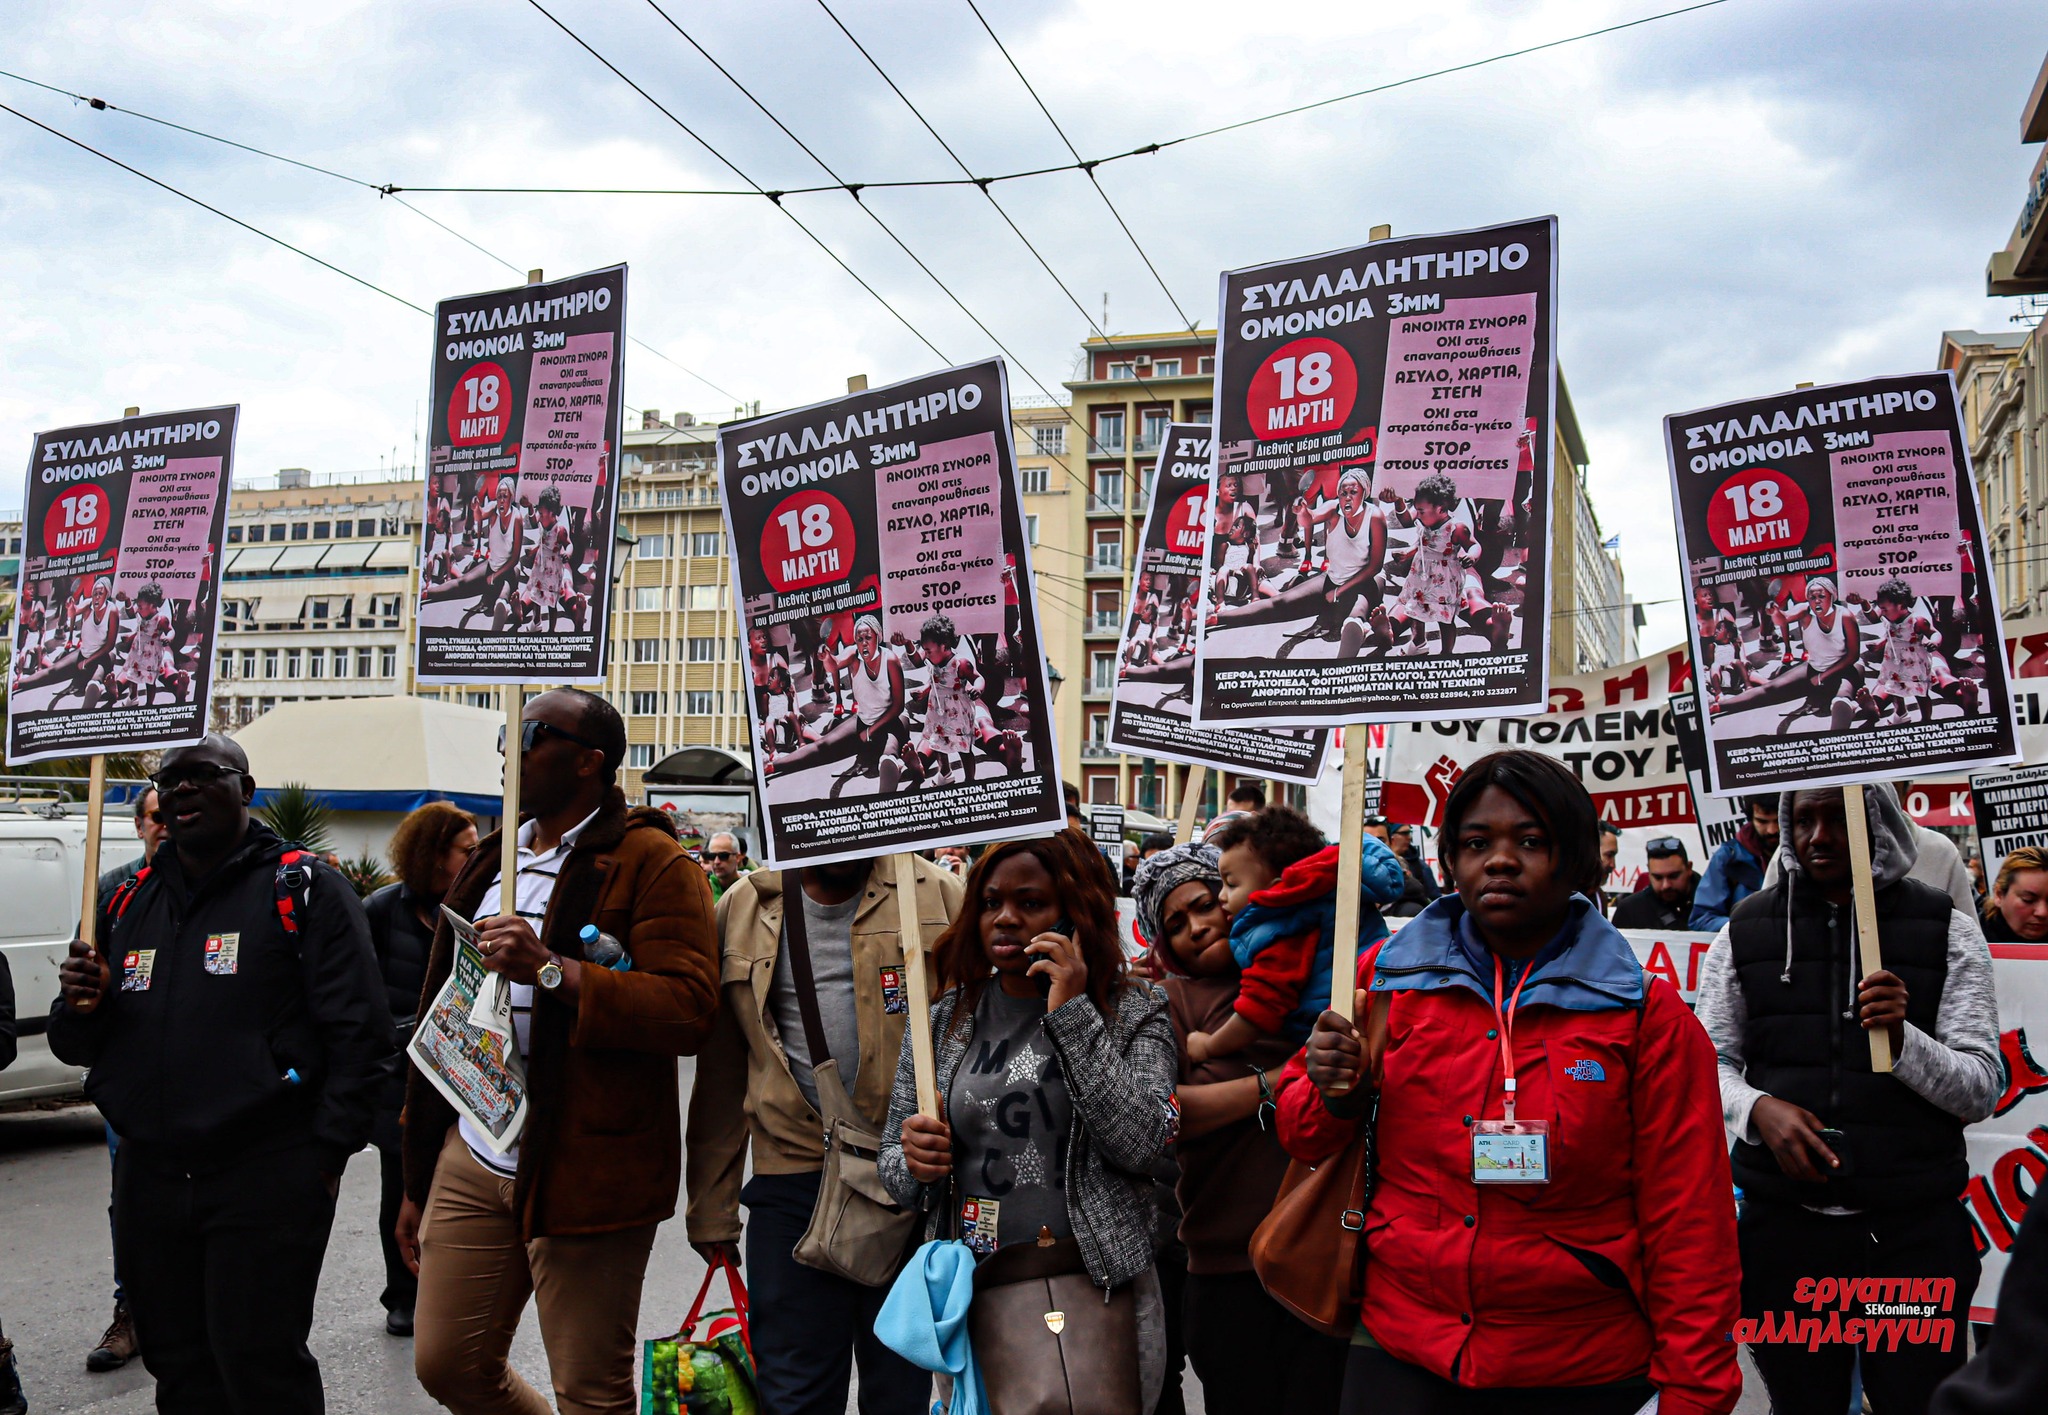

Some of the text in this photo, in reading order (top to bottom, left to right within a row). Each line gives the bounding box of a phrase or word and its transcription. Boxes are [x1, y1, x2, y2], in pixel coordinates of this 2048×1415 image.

[1241, 243, 1529, 312] ΣΥΛΛΑΛΗΤΗΡΙΟ
[447, 287, 611, 336] ΣΥΛΛΑΛΗΤΗΡΙΟ
[1240, 293, 1440, 341] ΟΜΟΝΟΙΑ 3ΜΜ
[1402, 314, 1527, 333] ΑΝΟΙΧΤΑ ΣΥΝΟΡΑ
[446, 331, 565, 361] ΟΜΟΝΟΙΑ 3ΜΜ
[1465, 337, 1489, 346] στις
[1404, 346, 1521, 363] επαναπροωθήσεις
[1273, 352, 1332, 400] 18
[1395, 364, 1521, 384] ΑΣΥΛΟ, ΧΑΡΤΙΑ,
[464, 375, 499, 413] 18
[1431, 384, 1482, 400] ΣΤΕΓΗ
[1268, 398, 1334, 430] ΜΑΡΤΗ
[1453, 410, 1478, 418] στα
[1685, 389, 1936, 450] ΣΥΛΛΑΛΗΤΗΡΙΟ
[460, 415, 499, 438] ΜΑΡΤΗ
[737, 384, 982, 468] ΣΥΛΛΑΛΗΤΗΡΙΟ
[1387, 418, 1512, 436] στρατόπεδα-γκέτο
[42, 420, 220, 462] ΣΥΛΛΑΛΗΤΗΡΙΟ
[1424, 441, 1471, 456] STOP
[1690, 430, 1870, 474] ΟΜΟΝΟΙΑ 3ΜΜ
[1383, 455, 1508, 474] στους φασίστες
[1840, 446, 1945, 465] ΑΝΟΙΧΤΑ ΣΥΝΟΡΑ
[41, 454, 165, 484] ΟΜΟΝΟΙΑ 3ΜΜ
[741, 441, 916, 496] ΟΜΟΝΟΙΑ 3ΜΜ
[886, 453, 991, 483] ΑΝΟΙΧΤΑ ΣΥΝΟΡΑ
[1896, 464, 1918, 472] στις
[941, 478, 962, 489] στις
[1846, 471, 1946, 488] επαναπροωθήσεις
[892, 485, 990, 510] επαναπροωθήσεις
[1724, 480, 1783, 521] 18
[1842, 486, 1950, 507] ΑΣΥΛΟ, ΧΑΡΤΙΑ,
[61, 494, 98, 528] 18
[887, 502, 994, 532] ΑΣΥΛΟ, ΧΑΡΤΙΑ,
[1876, 503, 1919, 518] ΣΤΕΓΗ
[56, 527, 97, 549] ΜΑΡΤΗ
[777, 504, 833, 552] 18
[920, 525, 962, 544] ΣΤΕΓΗ
[1728, 518, 1790, 547] ΜΑΡΤΗ
[1898, 524, 1919, 532] στα
[1843, 530, 1950, 549] στρατόπεδα-γκέτο
[781, 548, 840, 582] ΜΑΡΤΗ
[941, 550, 962, 559] στα
[1878, 550, 1918, 564] STOP
[887, 556, 994, 581] στρατόπεδα-γκέτο
[1845, 561, 1953, 578] στους φασίστες
[922, 580, 961, 598] STOP
[890, 593, 996, 615] στους φασίστες
[1215, 654, 1528, 681] ΚΕΕΡΦΑ, ΣΥΝΔΙΚΑΤΑ, ΚΟΙΝΟΤΗΤΕΣ ΜΕΤΑΝΑΣΤΩΝ, ΠΡΟΣΦΥΓΕΣ
[1217, 664, 1525, 690] ΑΠΟ ΣΤΡΑΤΟΠΕΔΑ, ΦΟΙΤΗΤΙΚΟΙ ΣΥΛΛΟΓΟΙ, ΣΥΛΛΟΓΙΚΟΤΗΤΕΣ,
[1251, 677, 1485, 697] ΑΝΘΡΩΠΟΙ ΤΩΝ ΓΡΑΜΜΑΤΩΝ ΚΑΙ ΤΩΝ ΤΕΧΝΩΝ
[1563, 747, 1655, 782] ΤΟΥ
[1564, 1066, 1592, 1075] NORTH
